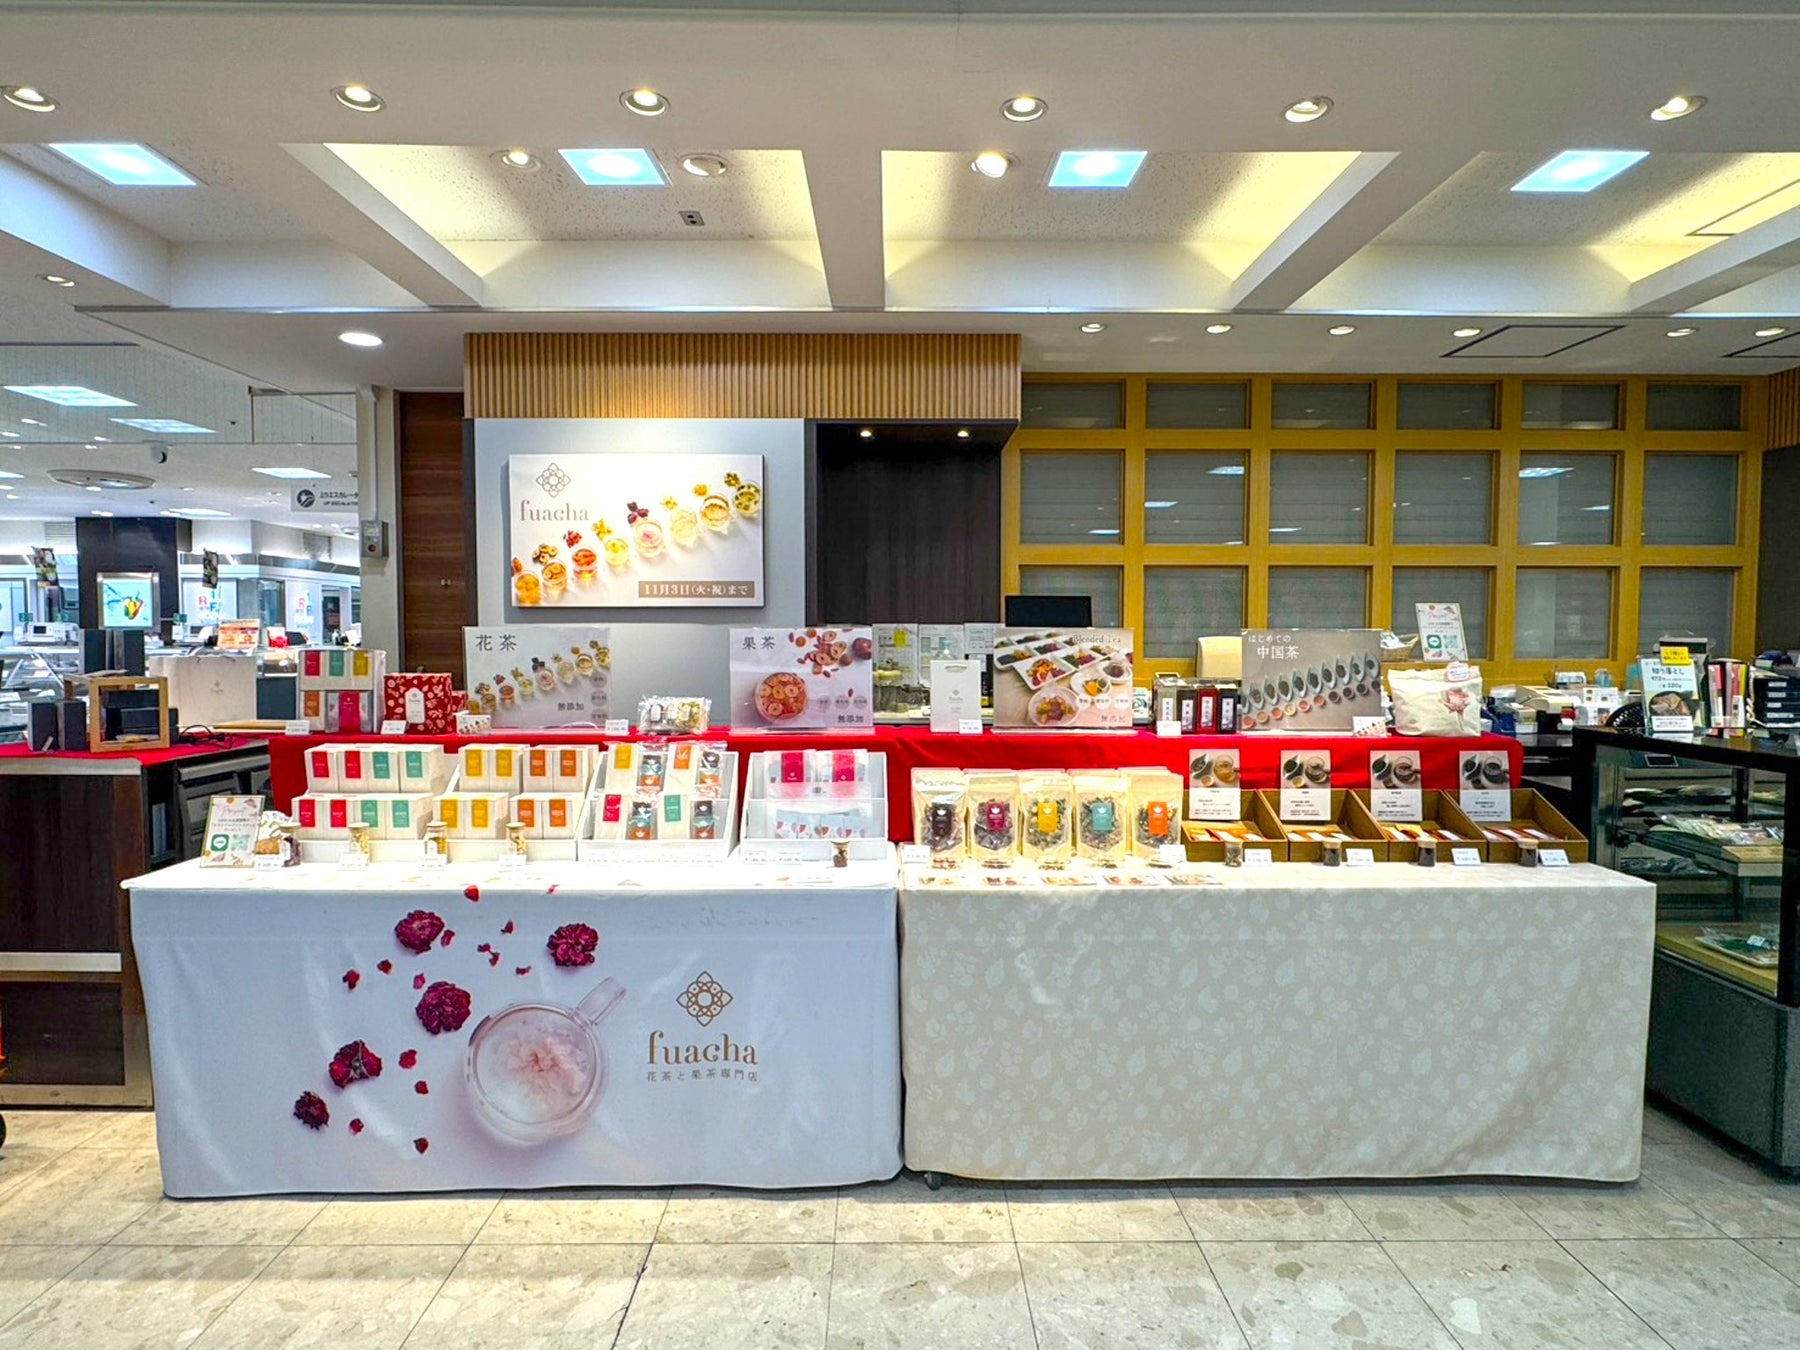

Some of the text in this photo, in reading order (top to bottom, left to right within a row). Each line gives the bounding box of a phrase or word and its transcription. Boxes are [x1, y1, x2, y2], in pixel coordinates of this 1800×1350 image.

[520, 500, 589, 521] fuacha
[475, 634, 517, 651] 花茶
[742, 636, 776, 651] 果茶
[1248, 634, 1292, 643] はじめての
[1257, 645, 1300, 660] 中国茶
[557, 702, 585, 711] 無添加
[837, 715, 864, 723] 無添加
[646, 1030, 759, 1065] fuacha
[646, 1068, 758, 1083] 花茶と果茶専門店
